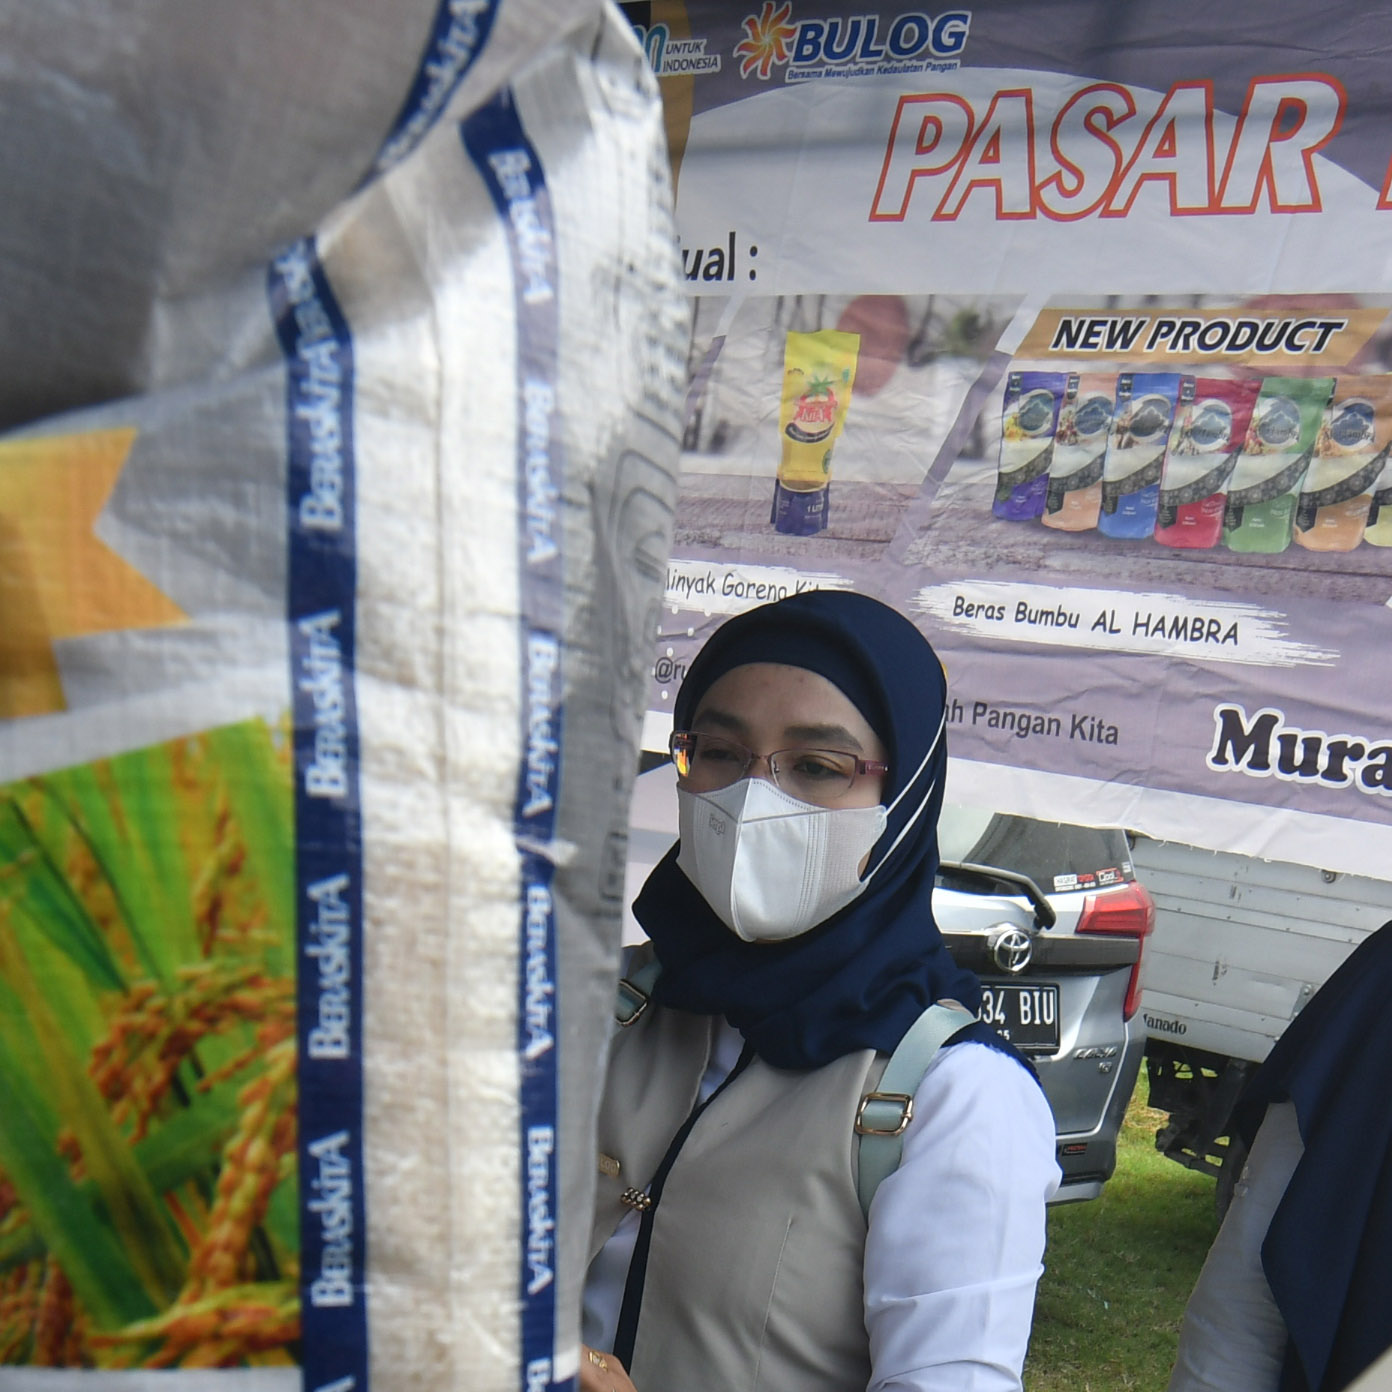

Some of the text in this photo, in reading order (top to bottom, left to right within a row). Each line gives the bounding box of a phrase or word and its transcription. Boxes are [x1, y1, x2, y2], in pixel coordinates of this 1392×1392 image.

[665, 40, 704, 55] UNTUK
[792, 12, 970, 64] BULOG
[663, 56, 720, 72] INDONESIA
[787, 68, 823, 81] Bersama
[925, 61, 958, 74] Pangan
[869, 72, 1349, 222] PASAR
[1050, 317, 1348, 354] NEW PRODUCT
[666, 569, 716, 600] inyak
[953, 595, 1241, 647] Beras Bumbu AL HAMBRA
[972, 700, 1063, 739] Pangan
[1069, 711, 1120, 746] Kita
[977, 990, 1054, 1025] 34 BIU
[1143, 1013, 1188, 1036] anado
